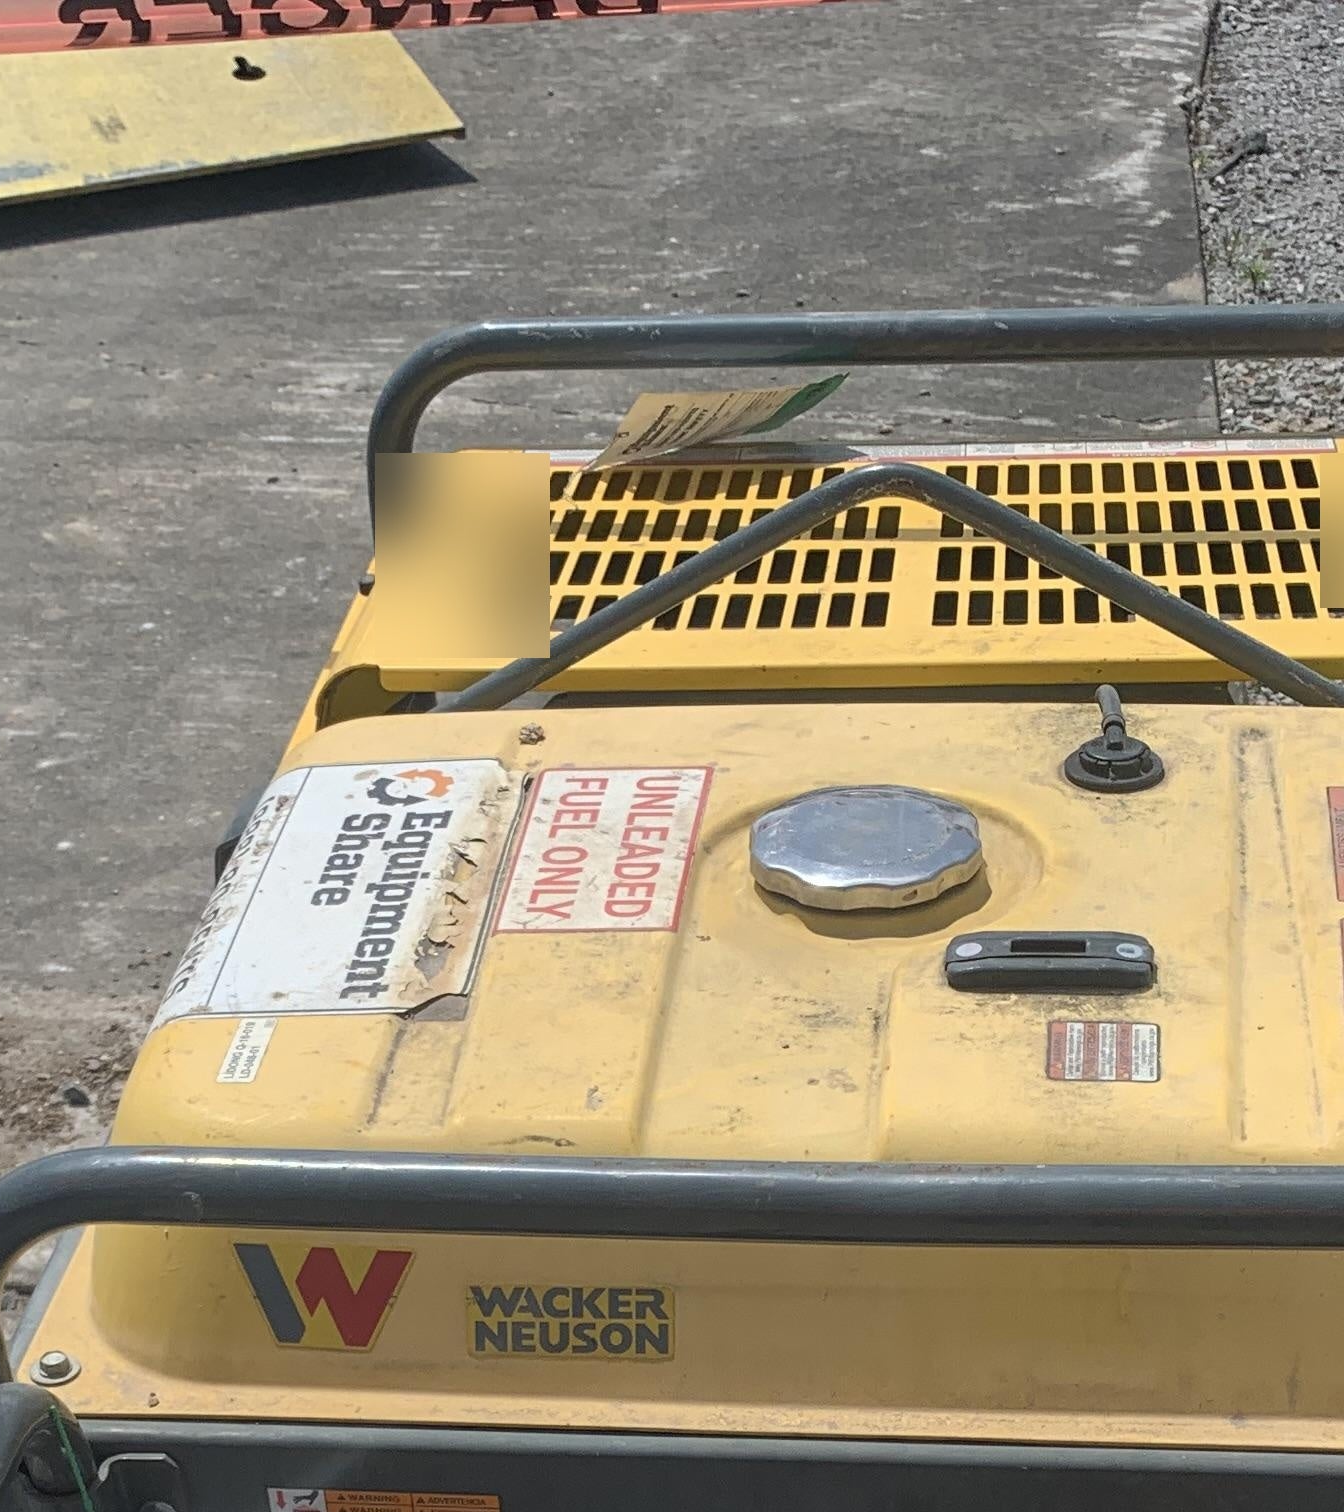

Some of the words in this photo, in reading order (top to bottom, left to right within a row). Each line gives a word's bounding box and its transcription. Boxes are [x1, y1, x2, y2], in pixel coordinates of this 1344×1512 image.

[549, 777, 607, 839] FUEL
[311, 811, 393, 907] Share
[604, 775, 683, 918] UNLEADED
[339, 809, 454, 1000] Equipment
[526, 845, 588, 920] ONLY
[469, 1286, 666, 1320] WACKER
[474, 1320, 669, 1354] NEUSON
[347, 1494, 400, 1503] WARNING
